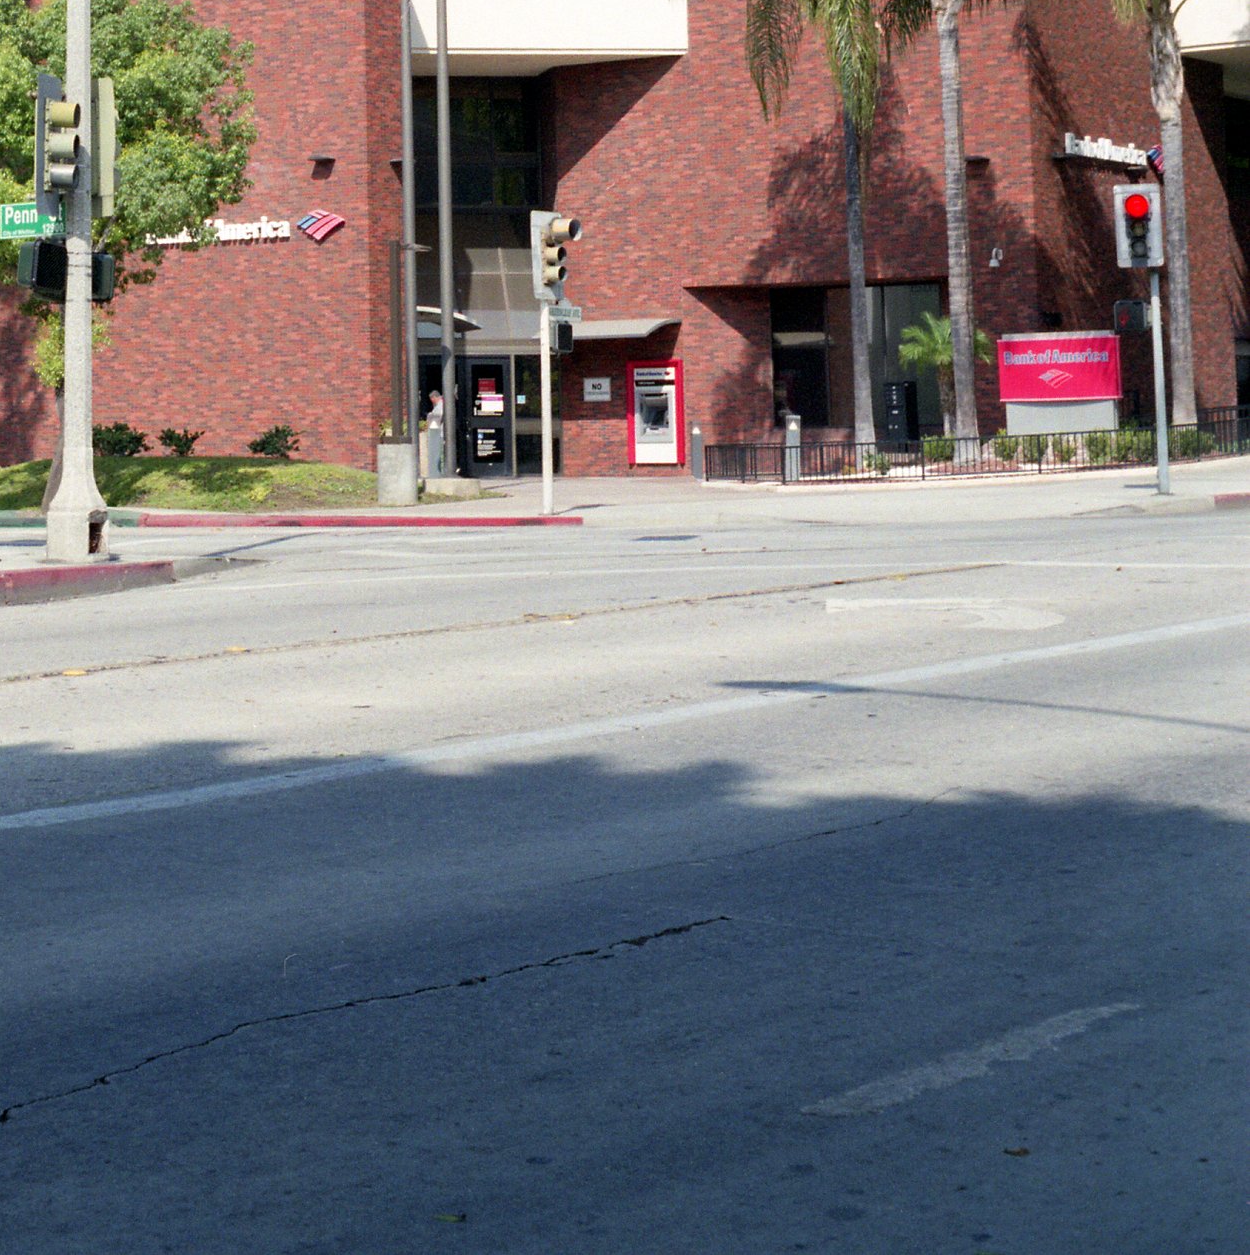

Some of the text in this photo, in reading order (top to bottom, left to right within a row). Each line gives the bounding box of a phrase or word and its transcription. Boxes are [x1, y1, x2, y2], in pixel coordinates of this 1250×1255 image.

[5, 206, 38, 225] Penn
[1004, 348, 1109, 365] Bank of America
